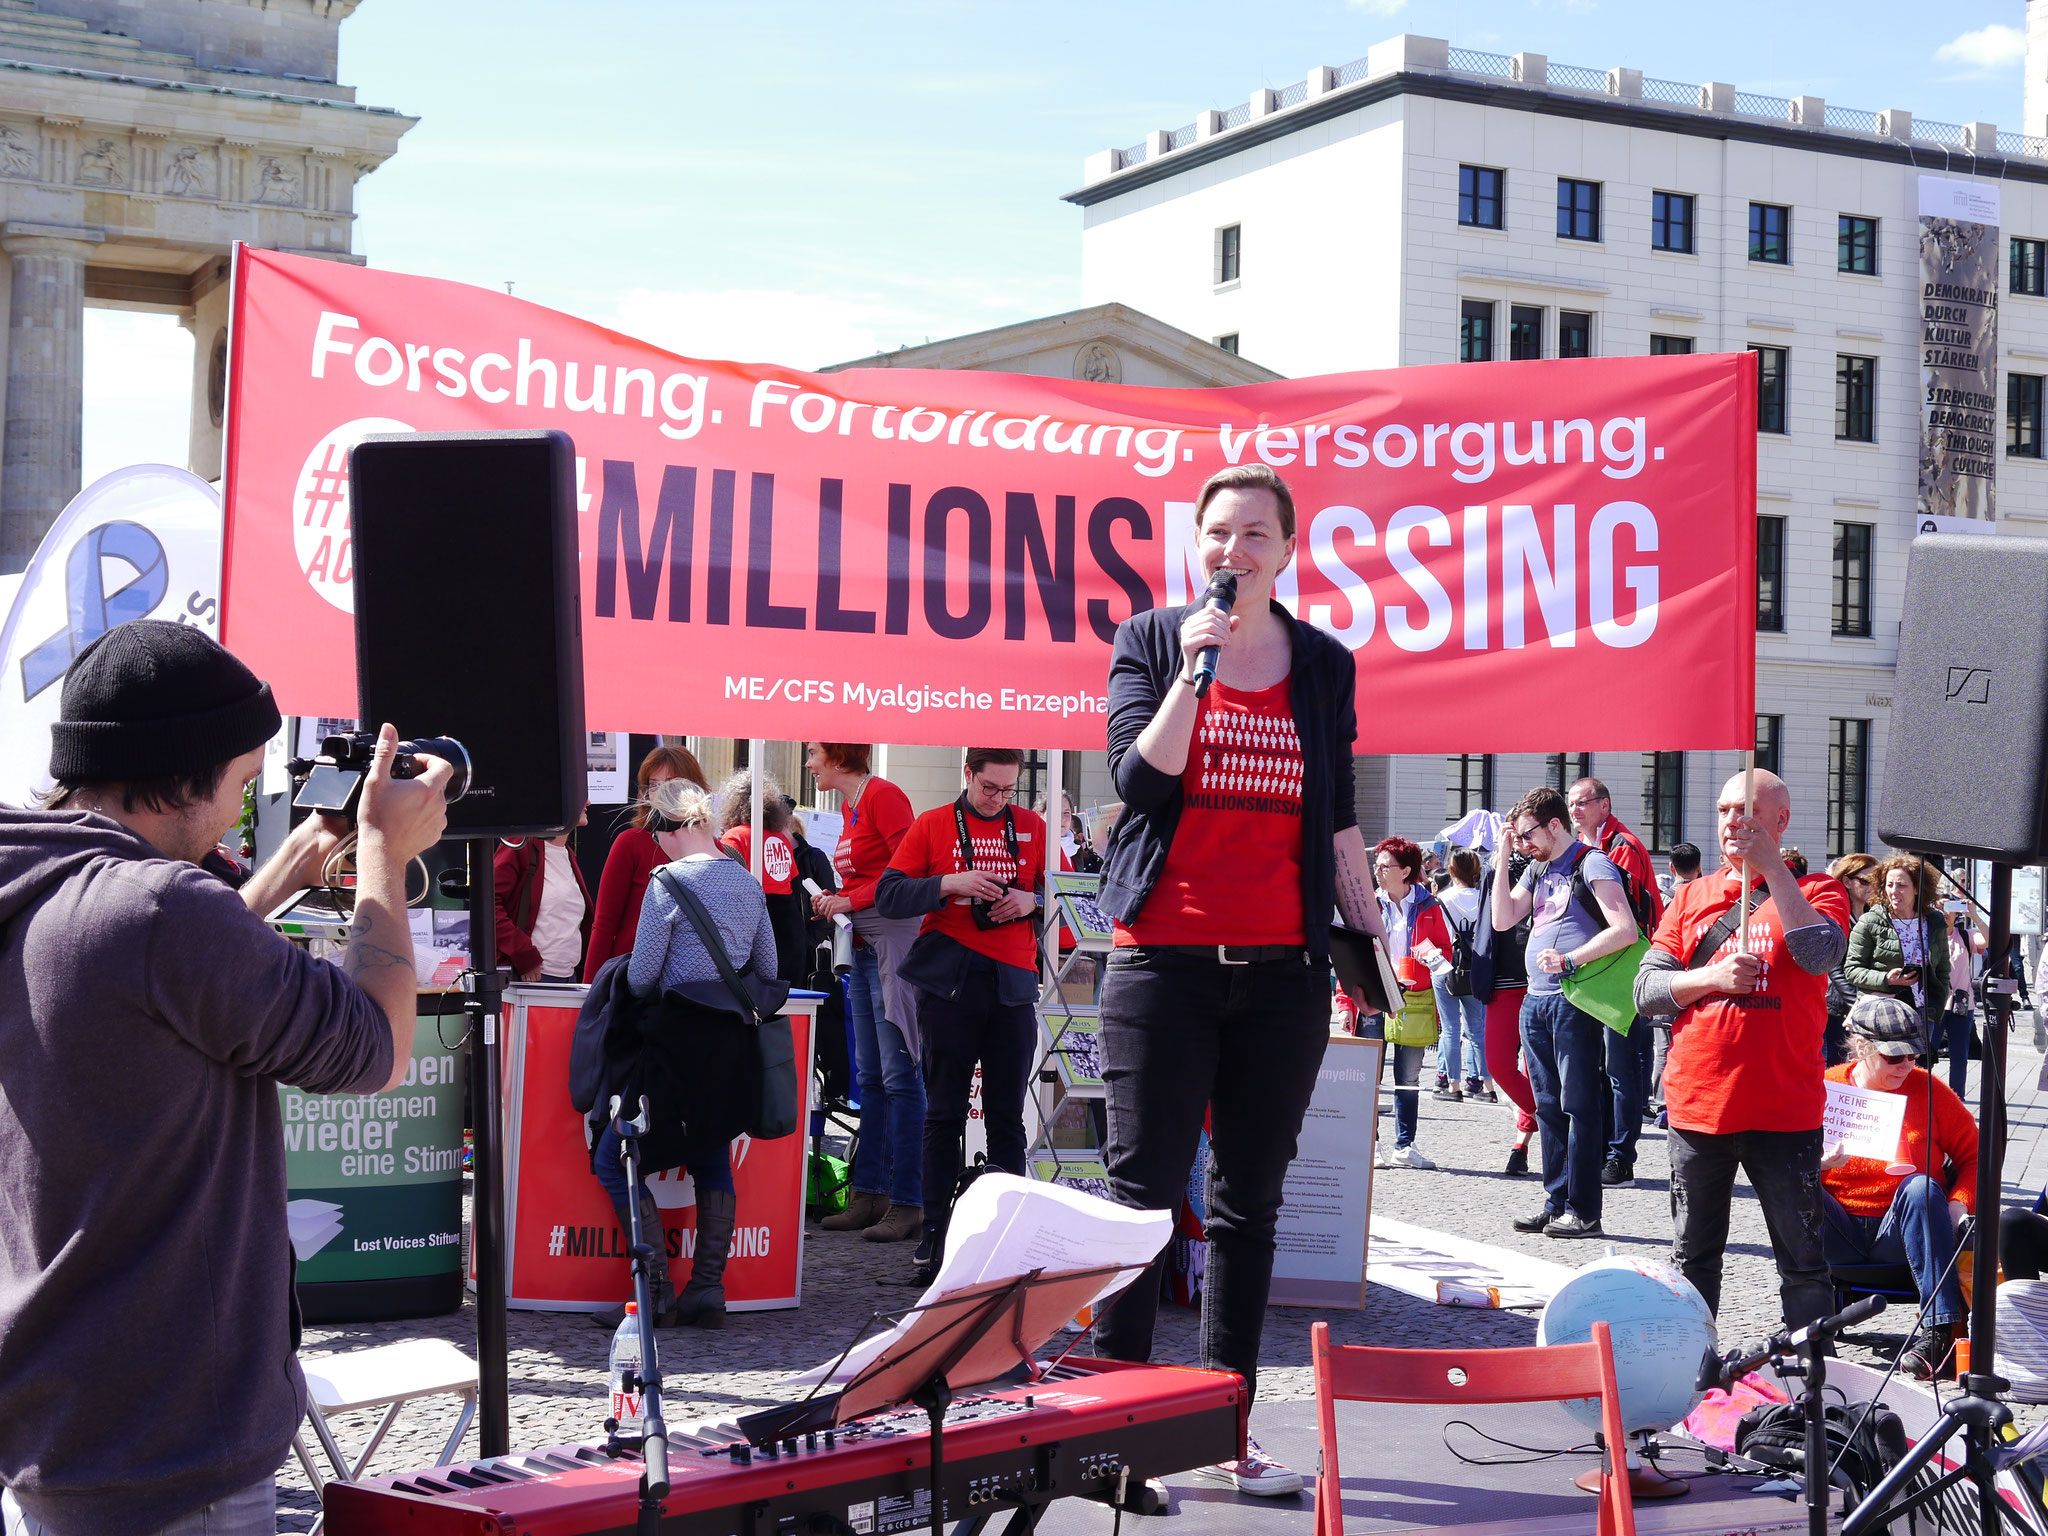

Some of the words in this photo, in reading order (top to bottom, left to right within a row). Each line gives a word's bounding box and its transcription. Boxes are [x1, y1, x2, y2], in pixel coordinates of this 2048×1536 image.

[1924, 283, 1997, 306] DEMOKRATIE
[1924, 305, 1967, 323] DURCH
[1924, 327, 1972, 345] KULTUR
[1924, 347, 1979, 369] STÄRKEN
[310, 310, 724, 440] Forschung.
[749, 379, 1193, 478] Fortbildung.
[1218, 415, 1666, 485] Versorgung.
[1927, 388, 1996, 410] STRENGTHEN
[1929, 410, 1995, 432] DEMOCRACY
[1947, 433, 1994, 454] THROUGH
[1952, 458, 1995, 477] CULTURE
[724, 675, 834, 703] ME/CFS
[842, 682, 993, 713] Myalgische
[1000, 688, 1109, 718] Enzepha
[959, 821, 967, 845] DIGITAL
[766, 842, 789, 863] #ME
[1317, 1068, 1366, 1083] myelitis
[286, 1093, 436, 1121] Betroffenen
[1838, 1094, 1868, 1108] KEINE
[283, 1113, 399, 1152] wieder
[1824, 1116, 1880, 1133] edikamente
[341, 1149, 395, 1176] eine
[404, 1145, 463, 1174] Stimm
[354, 1238, 382, 1252] Lost
[383, 1236, 426, 1251] Voices
[428, 1232, 461, 1247] Stiftung
